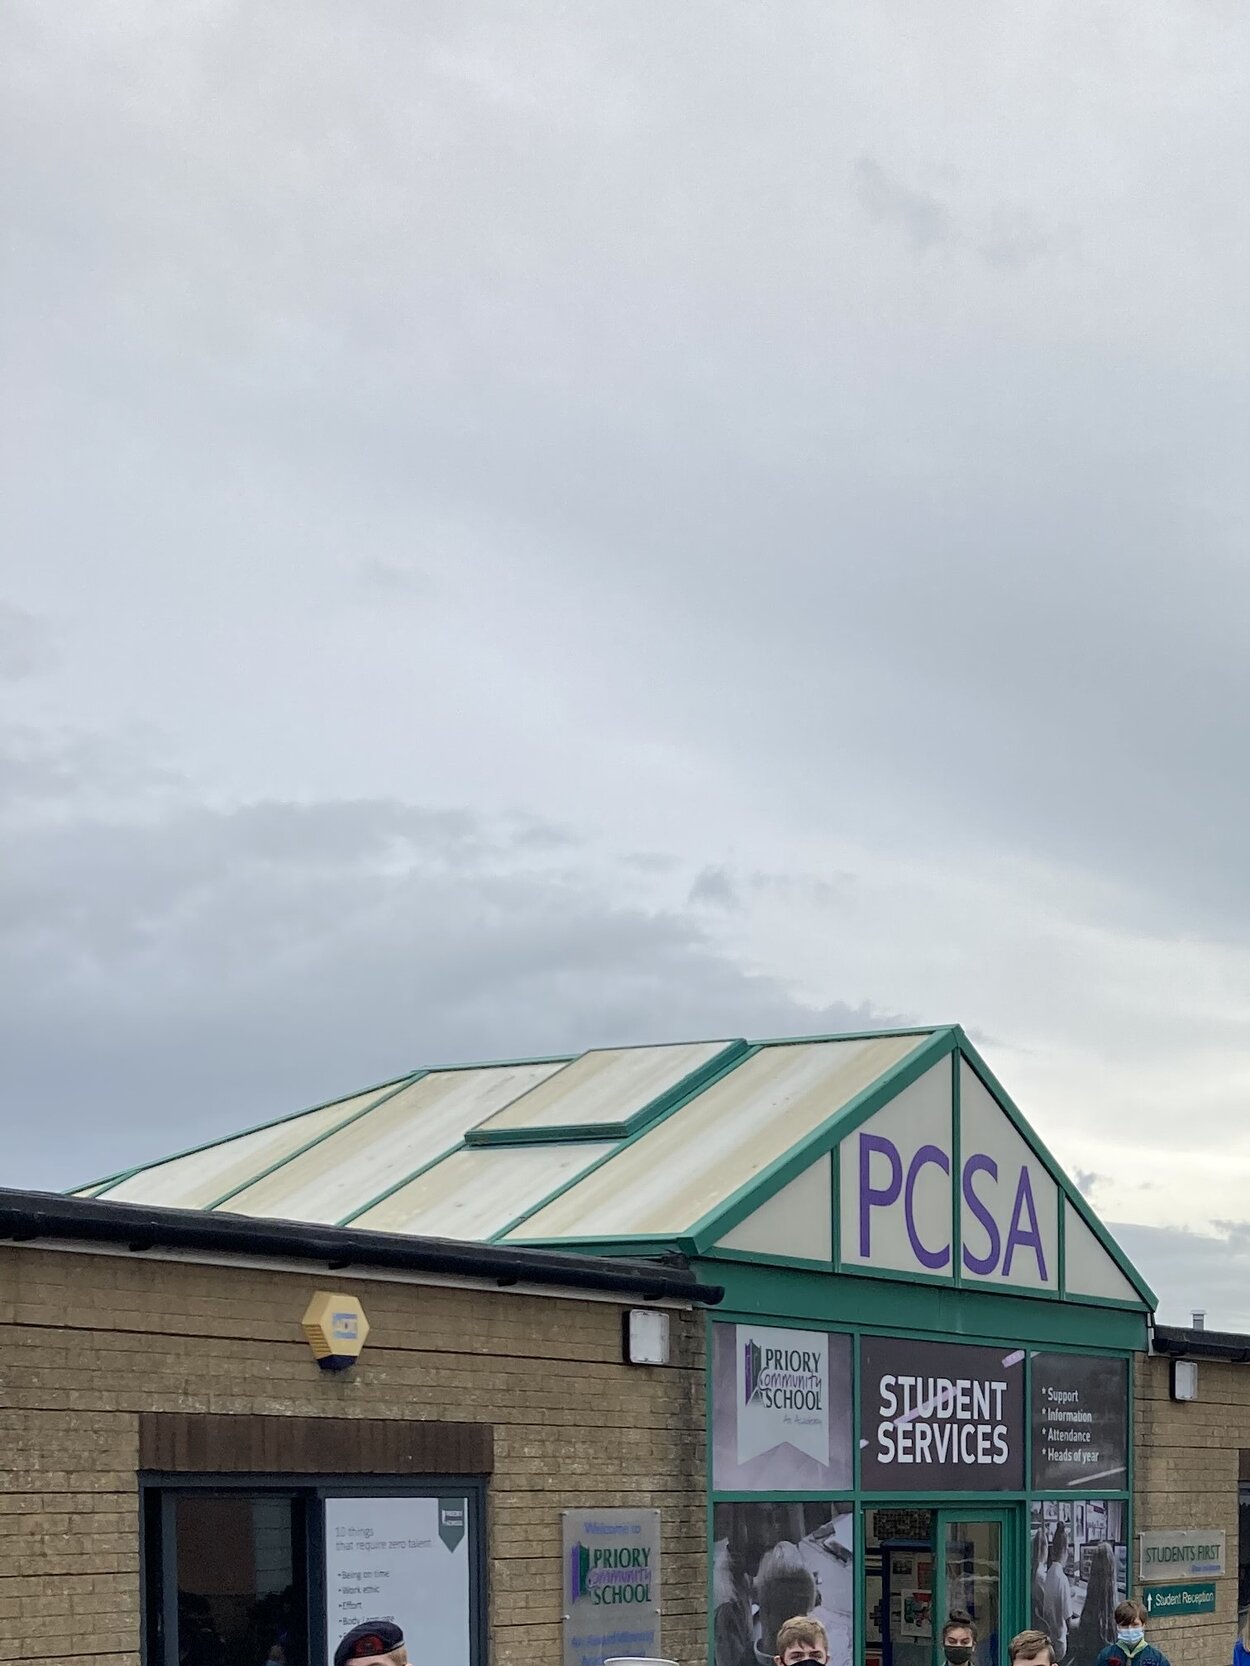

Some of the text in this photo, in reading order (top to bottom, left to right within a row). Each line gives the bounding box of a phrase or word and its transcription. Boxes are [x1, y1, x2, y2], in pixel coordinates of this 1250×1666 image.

[859, 1132, 1049, 1282] PCSA
[765, 1348, 821, 1373] PRIORY
[765, 1388, 823, 1411] SCHOOL
[879, 1374, 1008, 1421] STUDENT
[1047, 1386, 1079, 1404] Support
[1047, 1407, 1093, 1423] Information
[877, 1420, 1009, 1465] SERVICES
[1047, 1427, 1091, 1442] Attendance
[1047, 1447, 1100, 1465] Heads of year
[593, 1547, 652, 1569] PRIORY
[1145, 1544, 1221, 1563] STUDENTS FIRST
[592, 1583, 652, 1605] SCHOOL
[1155, 1591, 1215, 1607] Student Reception
